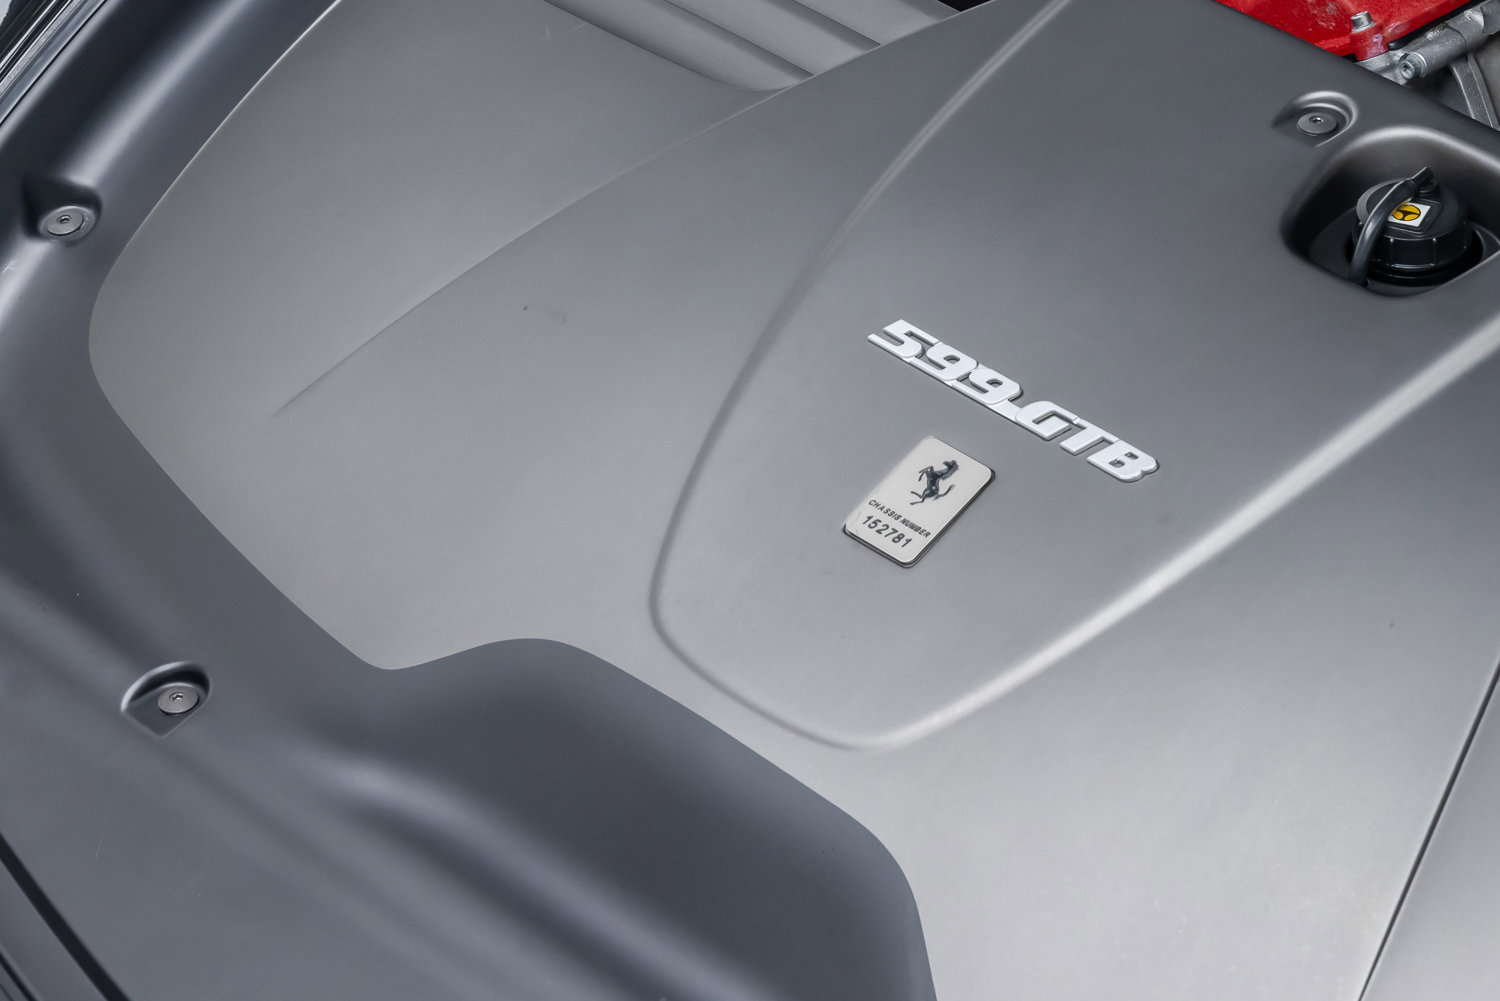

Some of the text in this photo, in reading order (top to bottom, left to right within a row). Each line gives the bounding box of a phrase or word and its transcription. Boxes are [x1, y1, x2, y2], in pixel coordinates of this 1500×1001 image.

[867, 319, 1159, 483] 599 GTB
[863, 515, 913, 549] 152781
[868, 499, 932, 539] CHASSIS NUMBER
